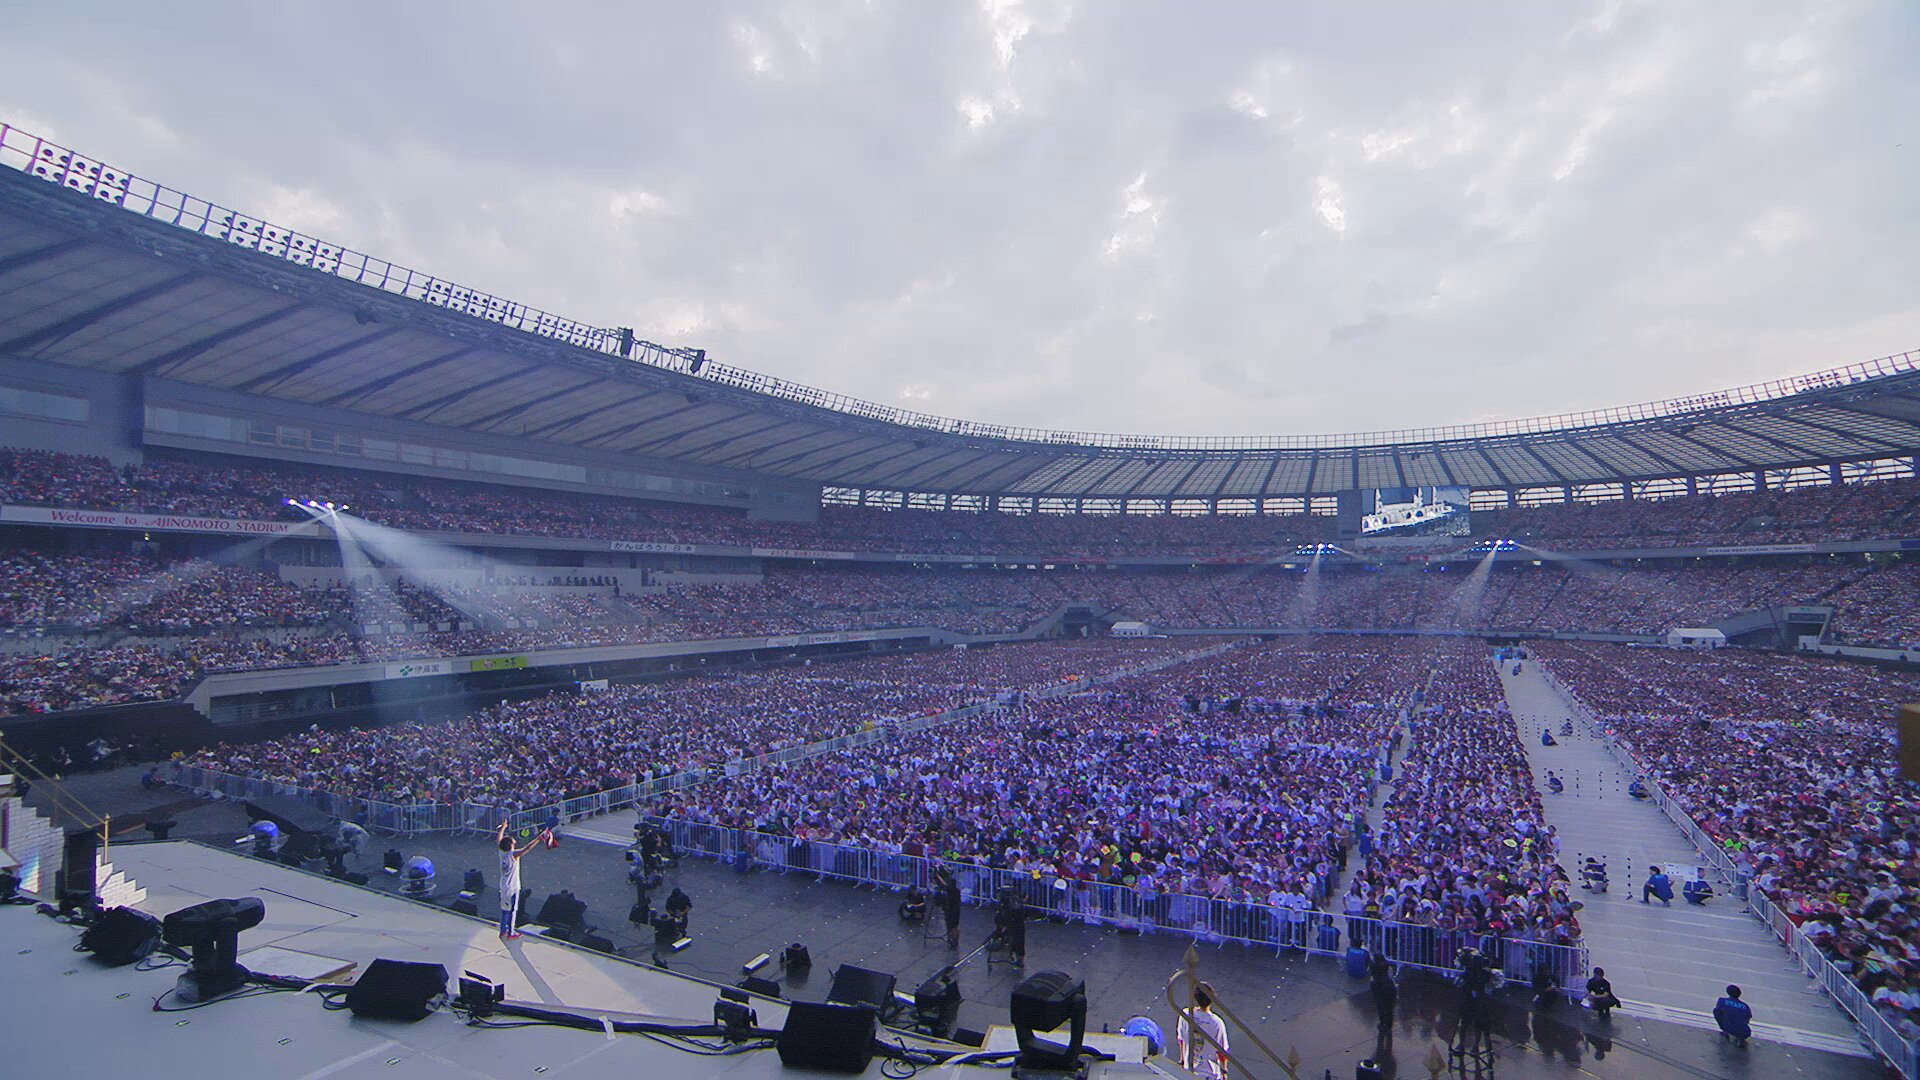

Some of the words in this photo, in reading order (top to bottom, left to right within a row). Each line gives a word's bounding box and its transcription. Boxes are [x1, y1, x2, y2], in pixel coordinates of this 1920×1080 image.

[51, 510, 116, 525] Welcome
[124, 515, 137, 526] to
[145, 517, 230, 530] AJINOMOTO
[236, 521, 288, 533] STADIUM
